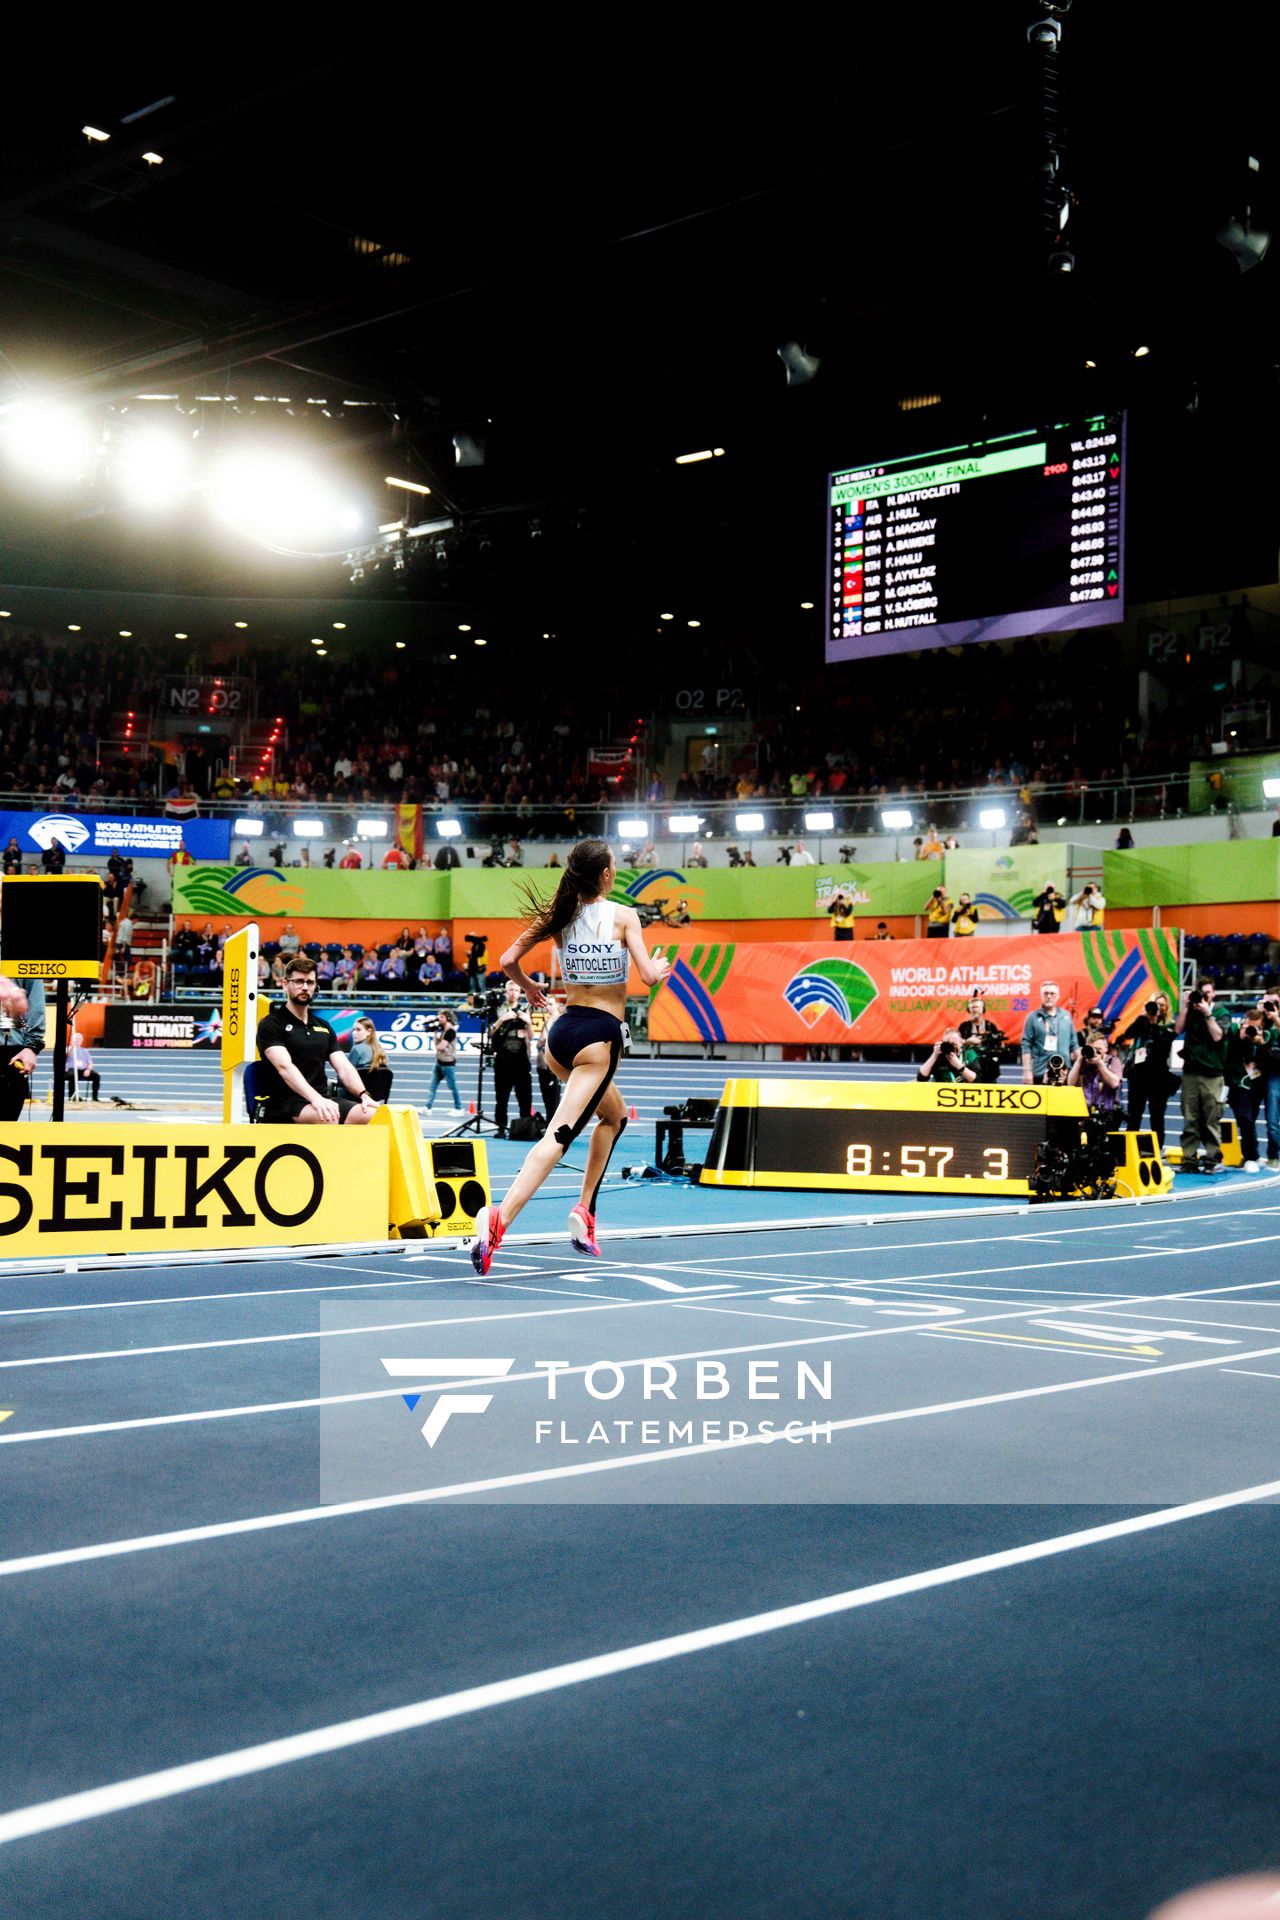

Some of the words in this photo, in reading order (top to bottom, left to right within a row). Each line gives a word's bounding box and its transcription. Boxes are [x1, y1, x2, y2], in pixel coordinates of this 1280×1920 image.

[836, 480, 890, 500] WOMEN'S
[894, 470, 936, 489] 3000M
[946, 462, 982, 478] FINAL
[836, 507, 842, 516] 1
[897, 483, 960, 504] BATTOCLETTI
[835, 522, 842, 532] 2
[896, 507, 920, 520] HULL
[834, 537, 842, 547] 3
[895, 518, 936, 536] MACKAY
[834, 552, 842, 562] 4
[834, 567, 841, 578] 5
[834, 582, 841, 592] 6
[834, 597, 840, 608] 7
[833, 612, 840, 623] 8
[833, 628, 840, 638] 9
[894, 612, 937, 628] NUTTALL
[170, 687, 200, 708] N2
[716, 688, 744, 709] P2
[96, 822, 131, 832] WORLD
[132, 824, 183, 834] ATHLETICS
[567, 944, 615, 954] SONY
[18, 963, 67, 976] SEIKO
[565, 958, 622, 971] BATTOCLETTI
[890, 966, 947, 984] WORLD
[949, 964, 1032, 982] ATHLETICS
[889, 985, 936, 998] INDOOR
[229, 968, 240, 1036] SEIKO
[889, 999, 943, 1012] KUJAWY
[946, 998, 1008, 1012] PORZE
[1012, 998, 1029, 1012] 26
[132, 1022, 194, 1038] ULTIMATE
[937, 1088, 1042, 1110] SEIKO
[447, 1222, 473, 1231] SEIKO
